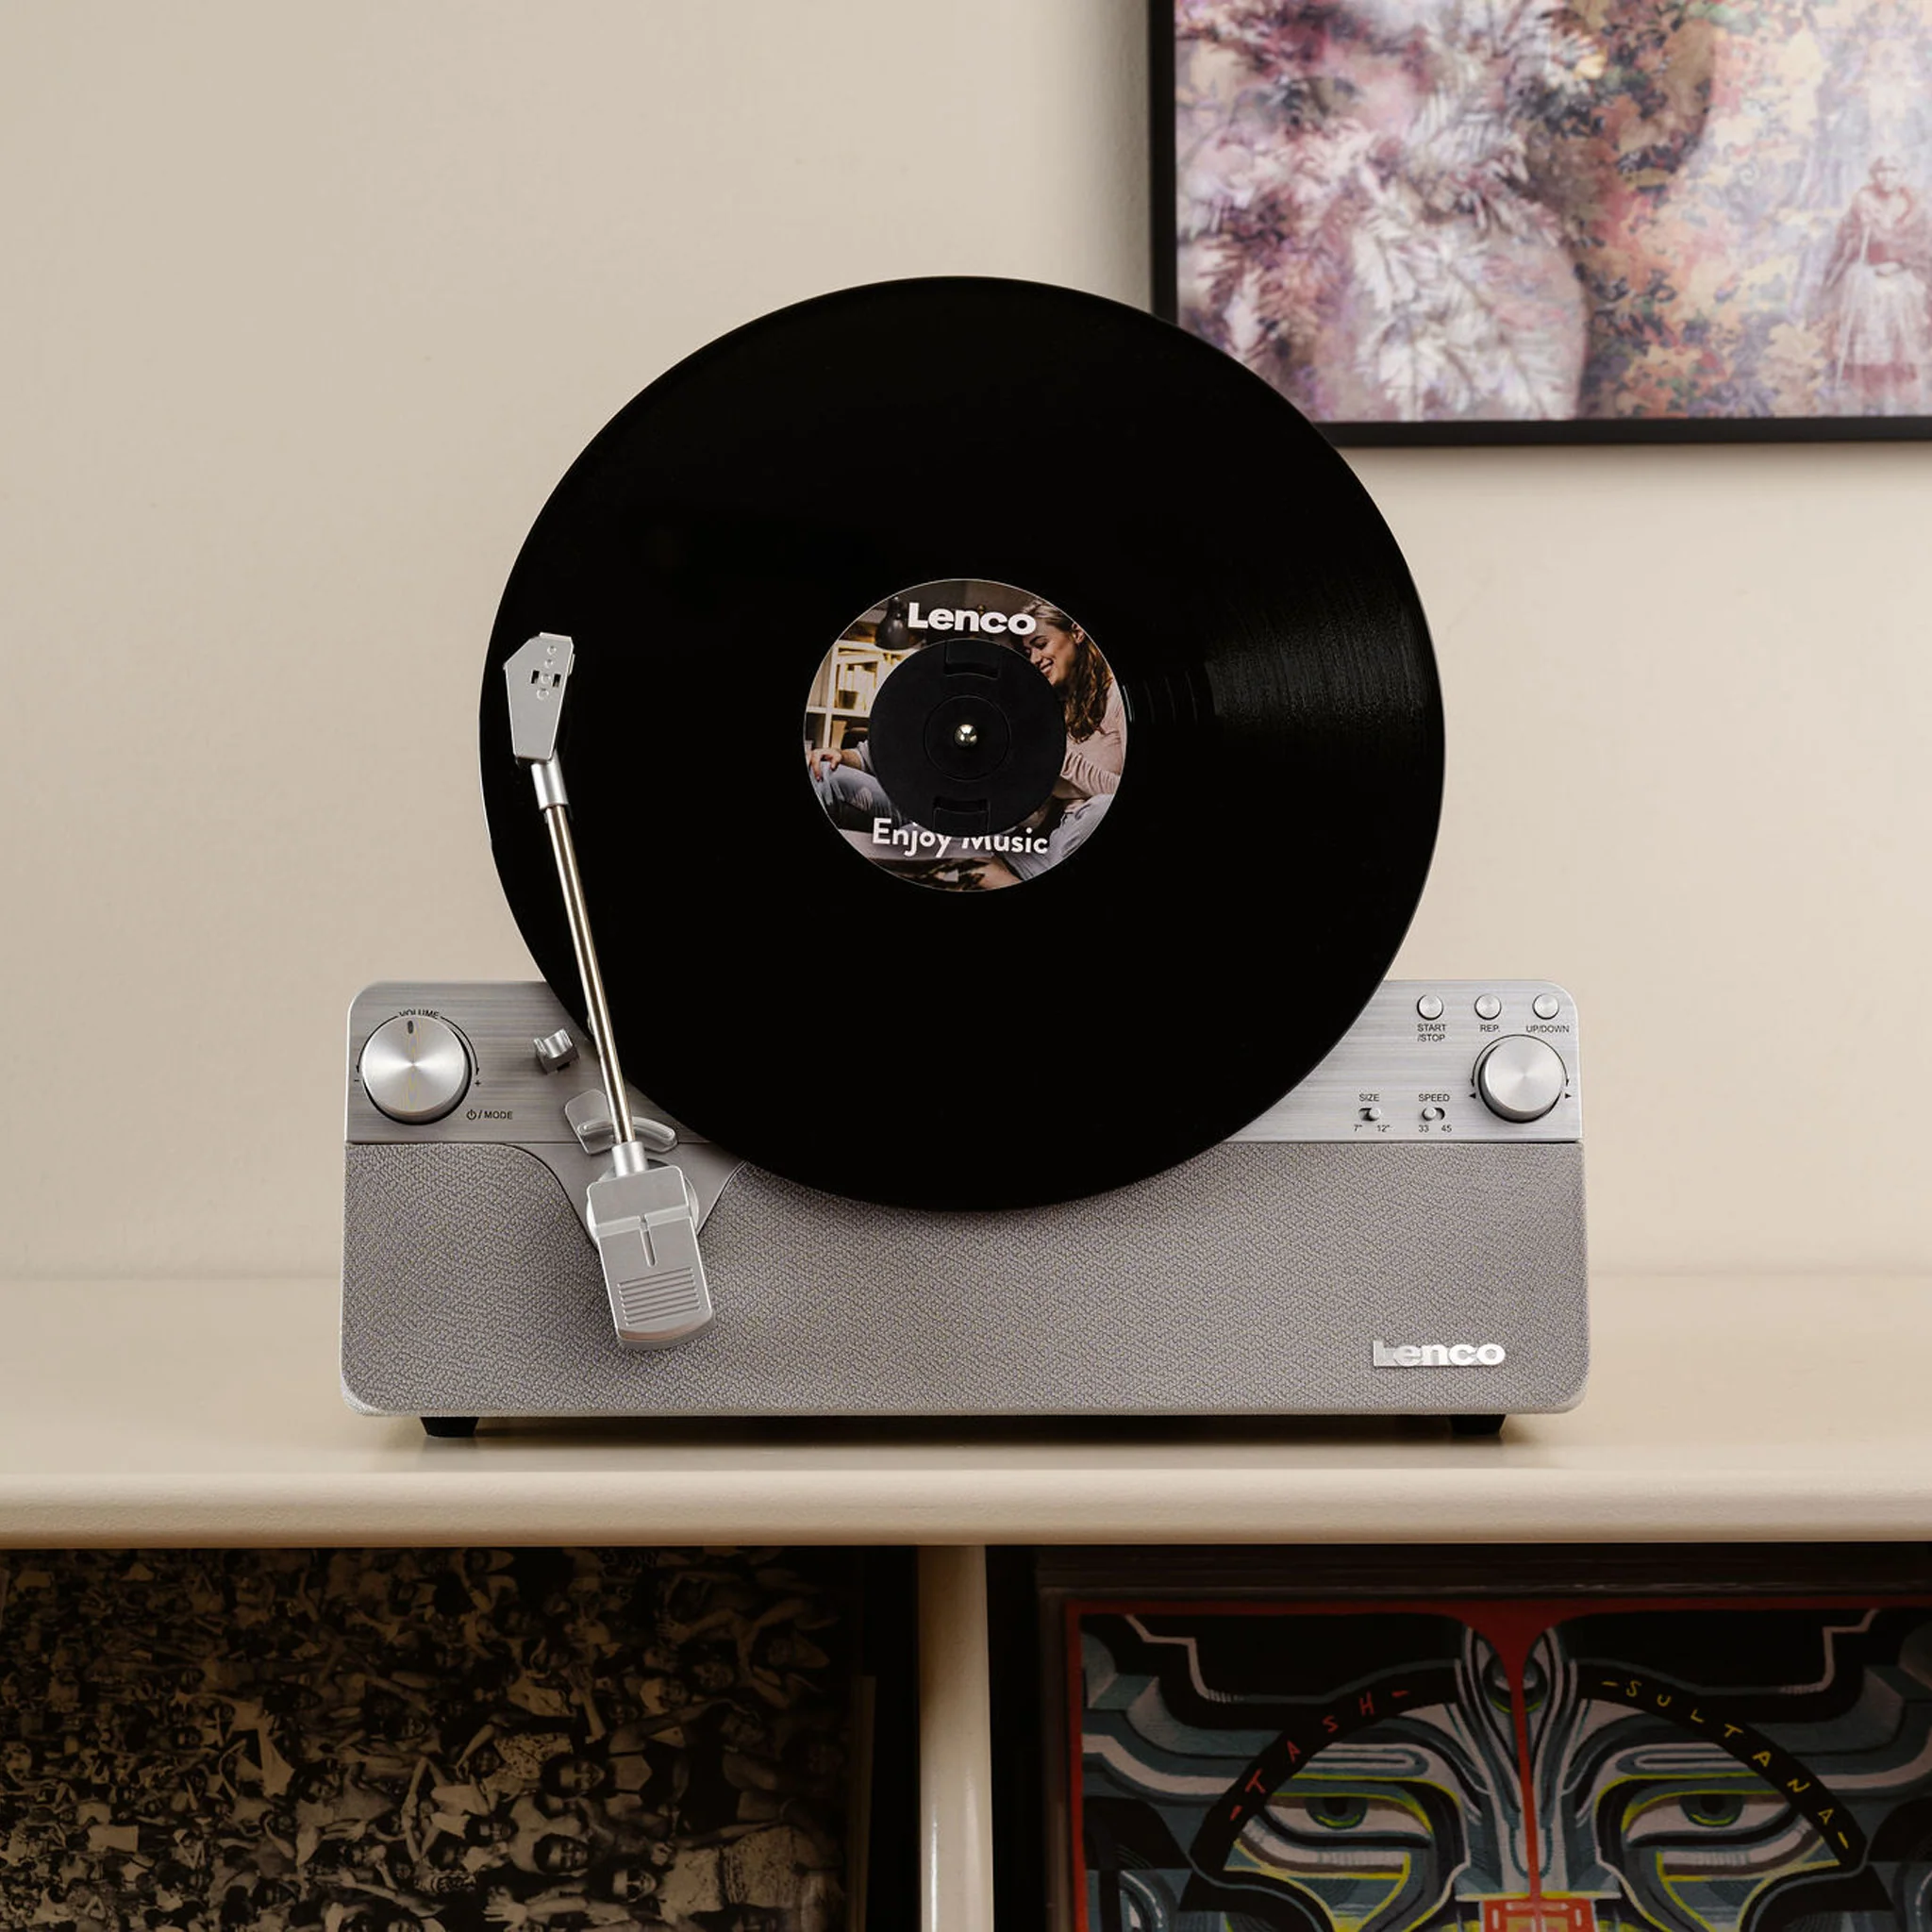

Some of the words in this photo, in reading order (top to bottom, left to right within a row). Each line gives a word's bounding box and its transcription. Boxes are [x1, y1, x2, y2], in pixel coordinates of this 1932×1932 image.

[908, 603, 1037, 636] Lenco
[873, 818, 952, 857] Enjoy
[398, 1008, 440, 1020] VOLUME
[1417, 1024, 1446, 1033] START
[1479, 1024, 1501, 1033] REP.
[1525, 1024, 1570, 1034] UP/DOWN
[1358, 1093, 1380, 1102] SIZE
[1418, 1093, 1450, 1102] SPEED
[1418, 1124, 1429, 1133] 33
[1441, 1124, 1453, 1132] 45
[1373, 1341, 1506, 1367] Lenco
